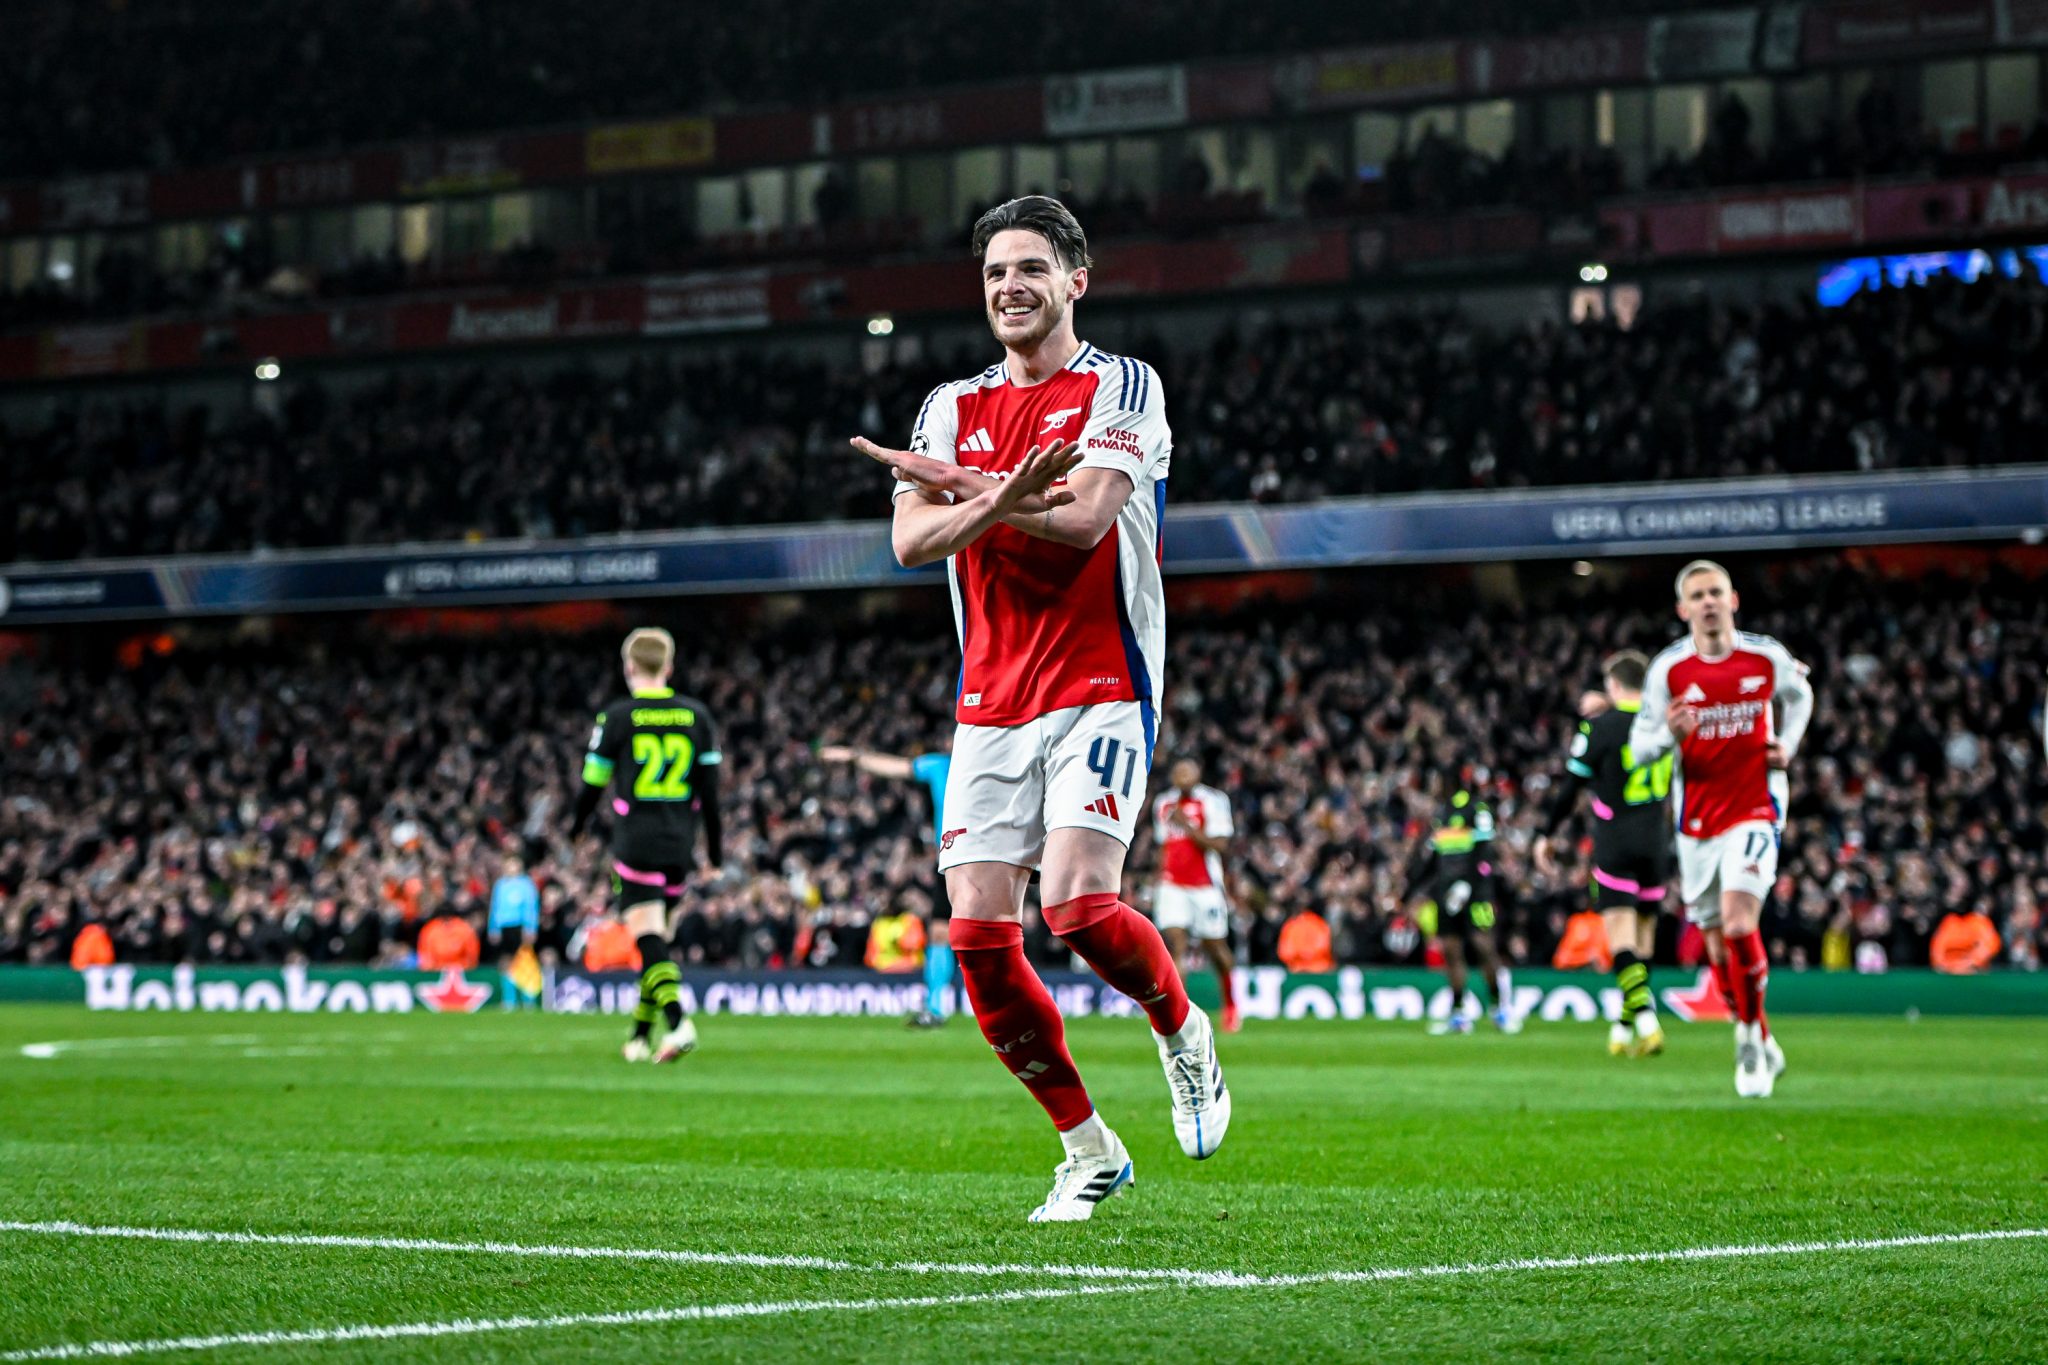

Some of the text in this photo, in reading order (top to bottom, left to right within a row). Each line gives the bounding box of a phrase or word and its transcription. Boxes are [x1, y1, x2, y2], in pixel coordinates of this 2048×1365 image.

[1087, 438, 1144, 464] RWANDA
[1106, 426, 1140, 444] VISIT
[1552, 493, 1889, 540] UEFA CHAMPIONS LEAGUE
[632, 732, 695, 801] 22
[1086, 736, 1138, 800] 41
[1744, 831, 1770, 860] 17
[85, 964, 413, 1013] Heineken
[704, 982, 926, 1016] CHAMPIONS
